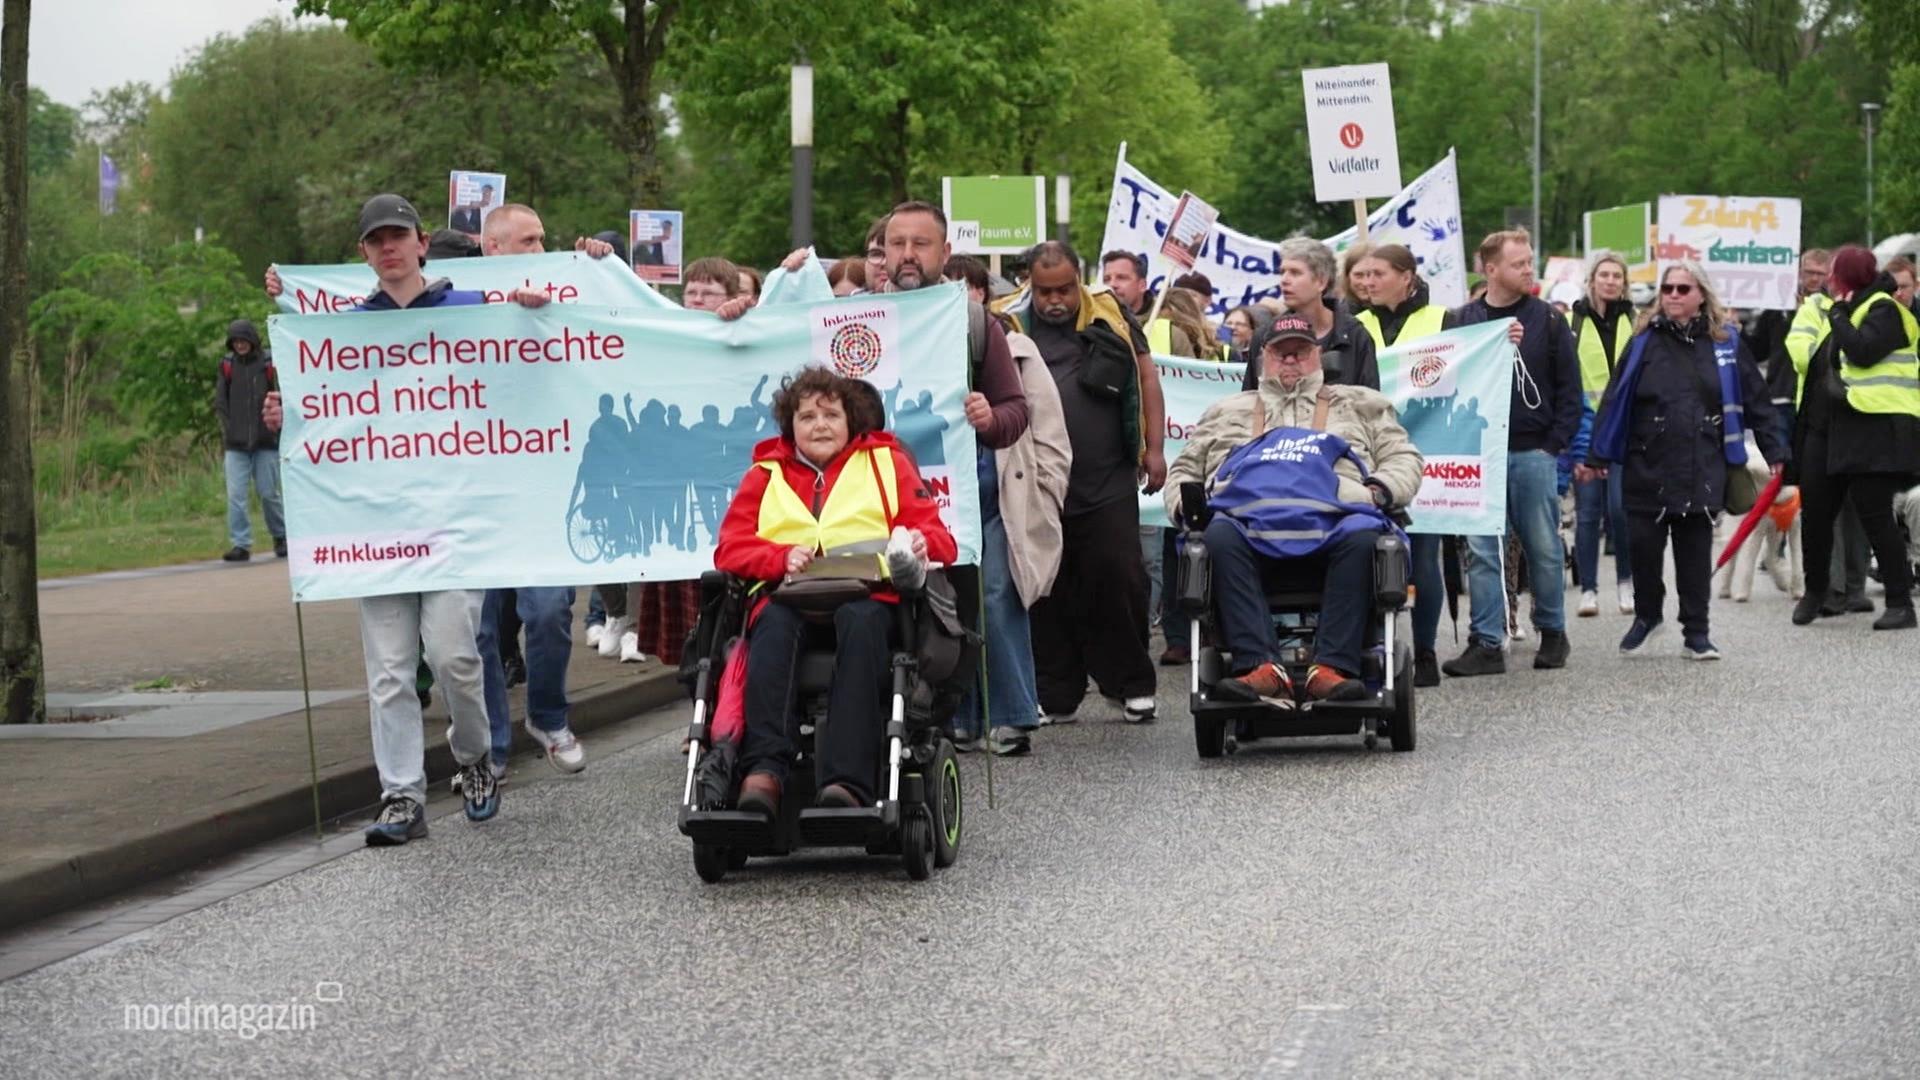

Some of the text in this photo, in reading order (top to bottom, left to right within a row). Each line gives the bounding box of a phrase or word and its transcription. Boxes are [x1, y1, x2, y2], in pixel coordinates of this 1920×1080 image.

[1315, 78, 1380, 91] Miteinander.
[1317, 94, 1374, 107] Mittendrin.
[298, 326, 626, 374] Menschenrechte
[301, 374, 487, 421] sind nicht
[303, 417, 572, 465] verhandelbar!
[313, 541, 431, 565] #Inklusion
